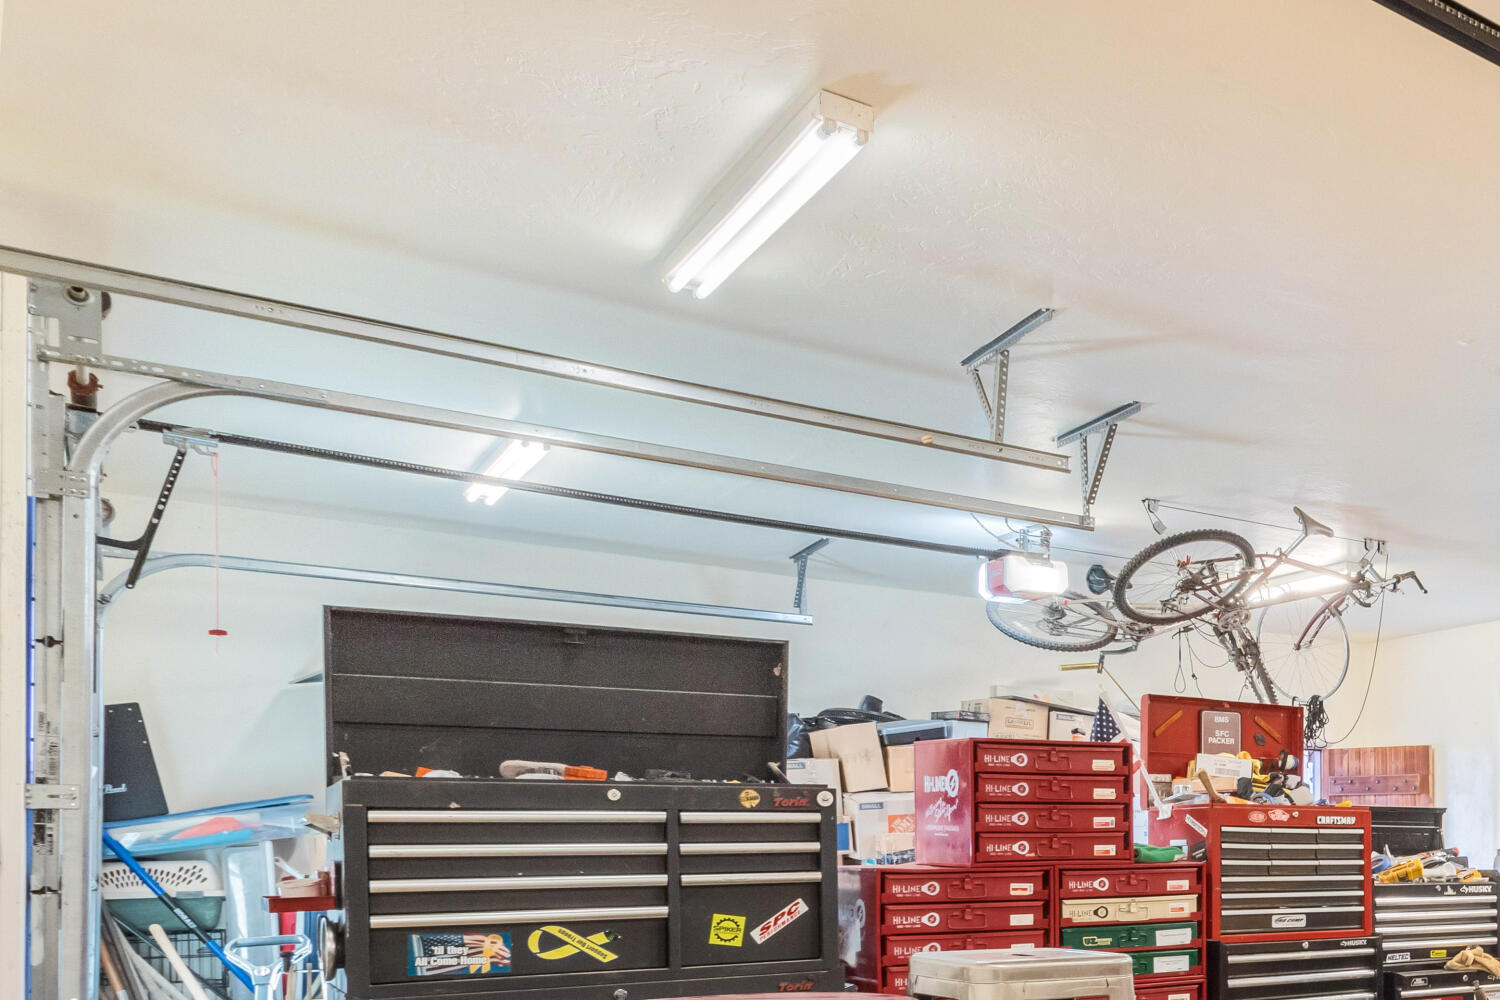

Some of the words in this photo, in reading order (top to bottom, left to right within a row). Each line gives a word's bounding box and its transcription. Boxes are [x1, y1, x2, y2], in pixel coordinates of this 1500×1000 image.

[1208, 737, 1235, 745] PACKER
[1468, 885, 1492, 893] HUSKY
[758, 901, 801, 936] SPC
[446, 946, 470, 956] they
[415, 957, 428, 966] All
[430, 957, 458, 966] Come
[459, 956, 488, 965] Home
